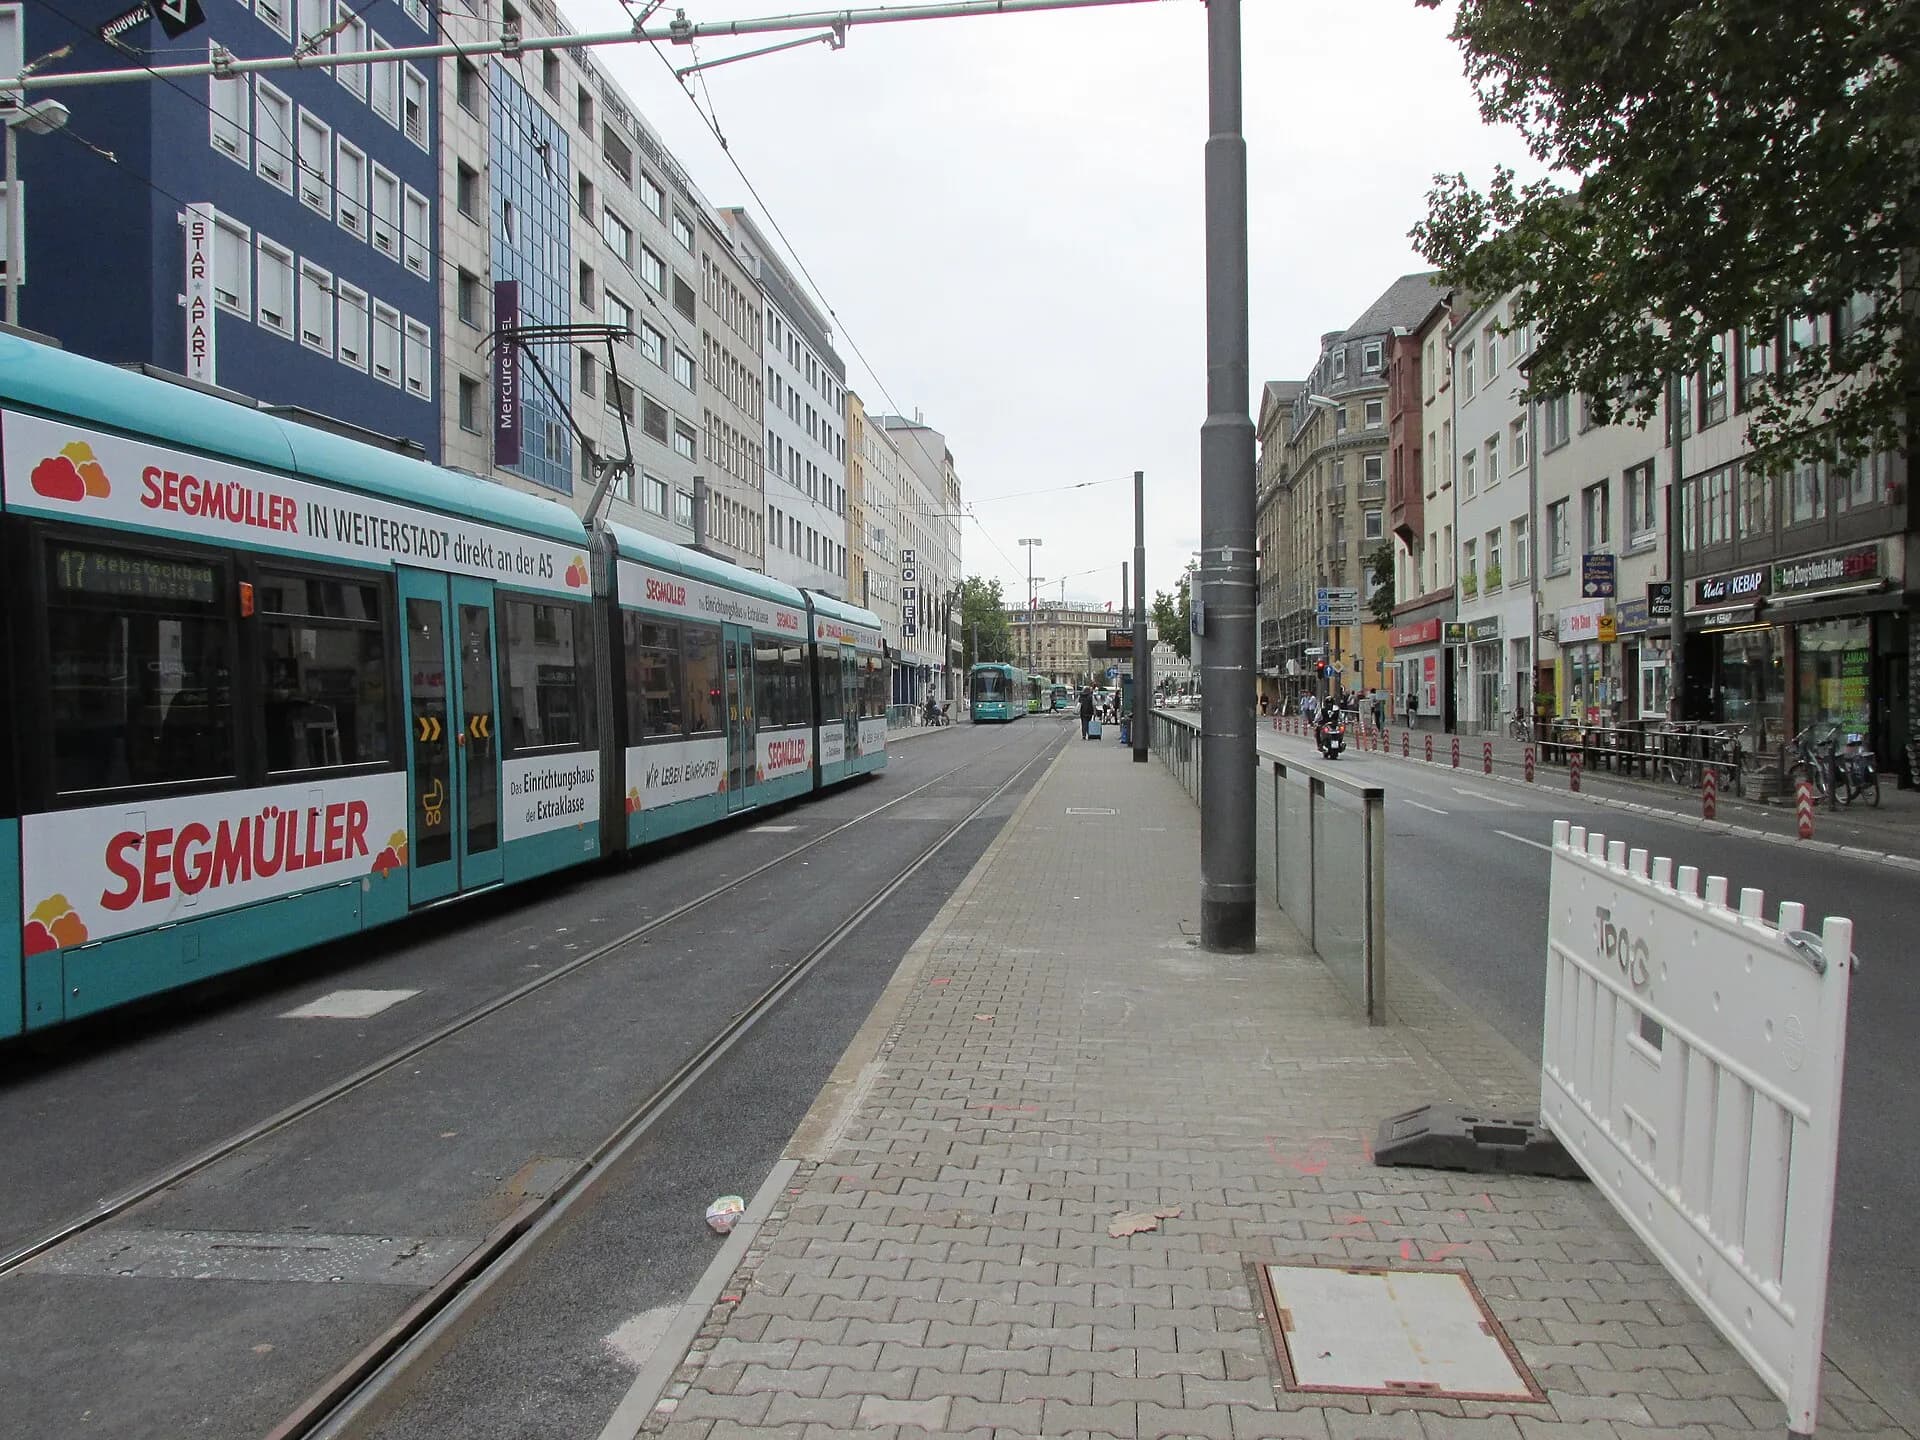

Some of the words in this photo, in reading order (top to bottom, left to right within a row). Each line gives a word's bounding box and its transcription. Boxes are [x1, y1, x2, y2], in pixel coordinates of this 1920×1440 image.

[191, 222, 205, 279] STAR
[191, 296, 206, 367] APART
[500, 355, 512, 429] Mercure
[140, 465, 298, 534] SEGMÜLLER
[306, 502, 329, 539] IN
[332, 508, 450, 561] WEITERSTADT
[453, 533, 494, 569] direkt
[497, 550, 512, 573] an
[516, 546, 534, 576] der
[538, 553, 554, 579] A5
[60, 550, 87, 589] 17
[1732, 572, 1762, 594] KEBAP
[646, 578, 686, 606] SEGMÜLLER
[903, 550, 914, 636] HOTEL
[768, 738, 806, 770] SEGMÜLLER
[510, 781, 523, 796] Das
[523, 765, 595, 793] Einrichtungshaus
[661, 764, 684, 786] LEBEN
[525, 809, 536, 823] der
[537, 795, 585, 820] Extraklasse
[99, 800, 370, 912] SEGMÜLLER
